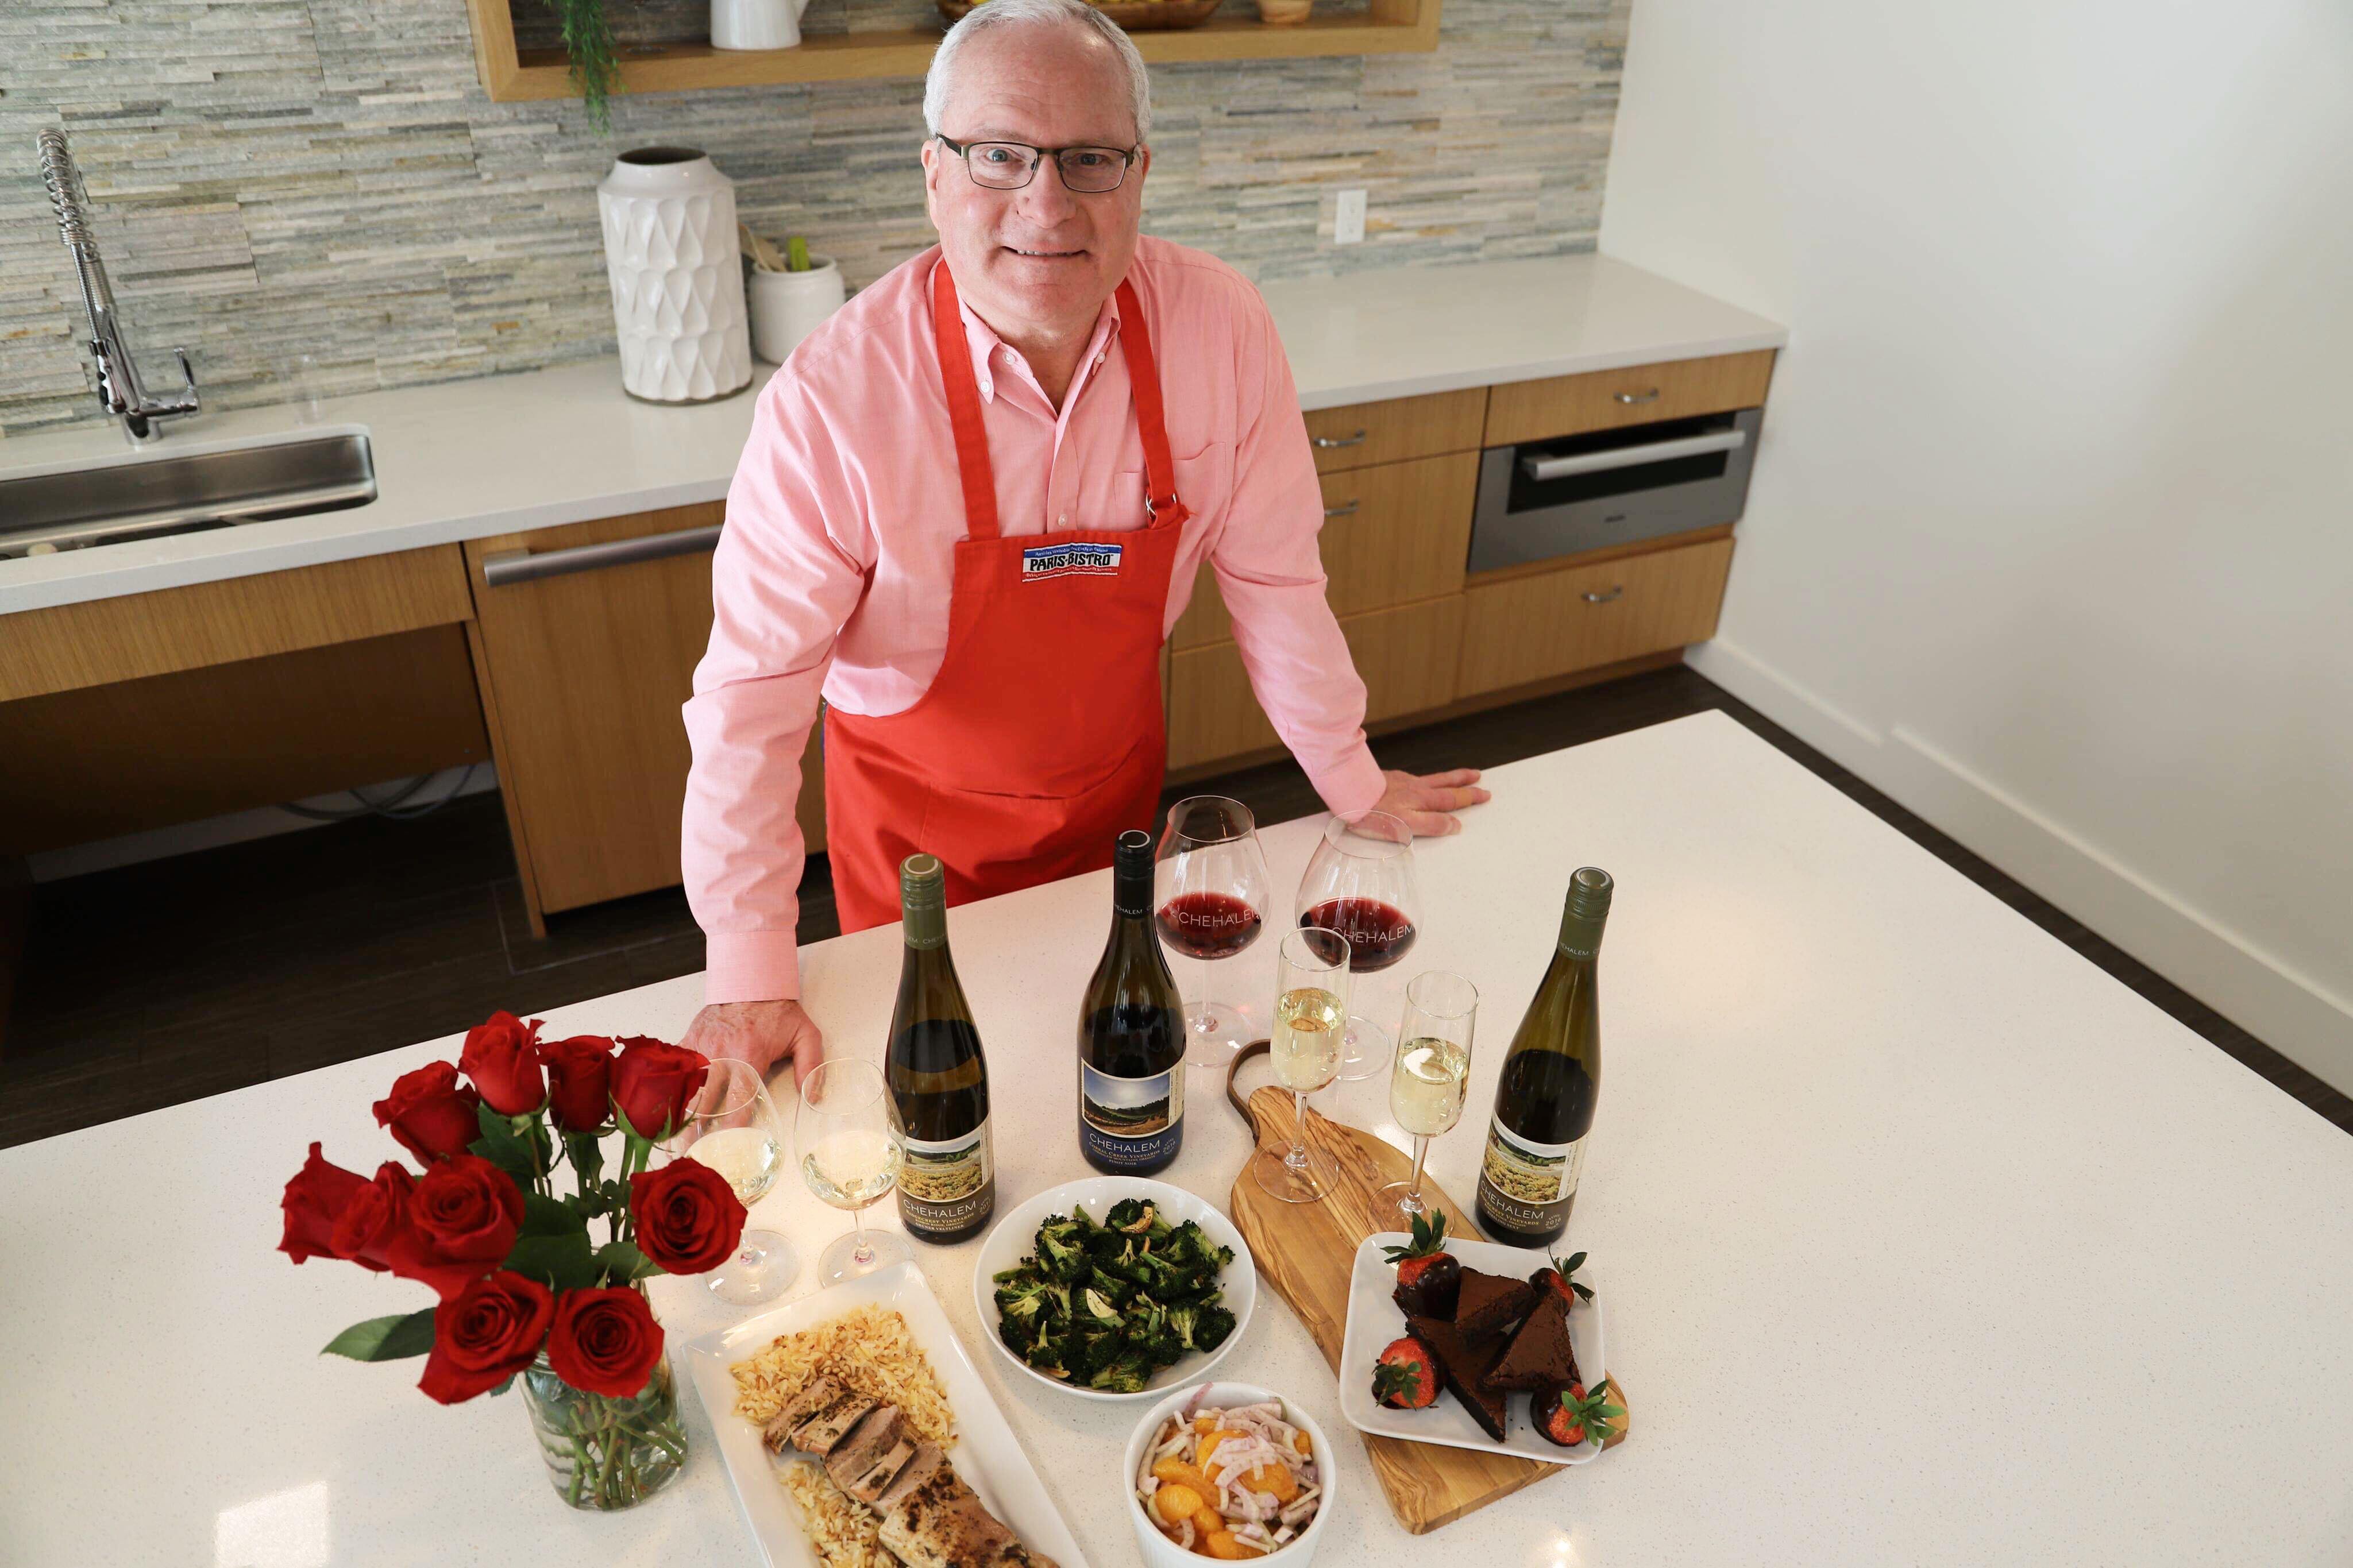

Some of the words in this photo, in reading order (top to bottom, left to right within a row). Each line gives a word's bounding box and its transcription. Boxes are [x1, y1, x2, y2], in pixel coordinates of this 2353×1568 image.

[1089, 1133, 1160, 1153] CHEHALEM
[903, 1199, 977, 1218] CHEHALEM
[1480, 1180, 1544, 1219] CHEHALEM
